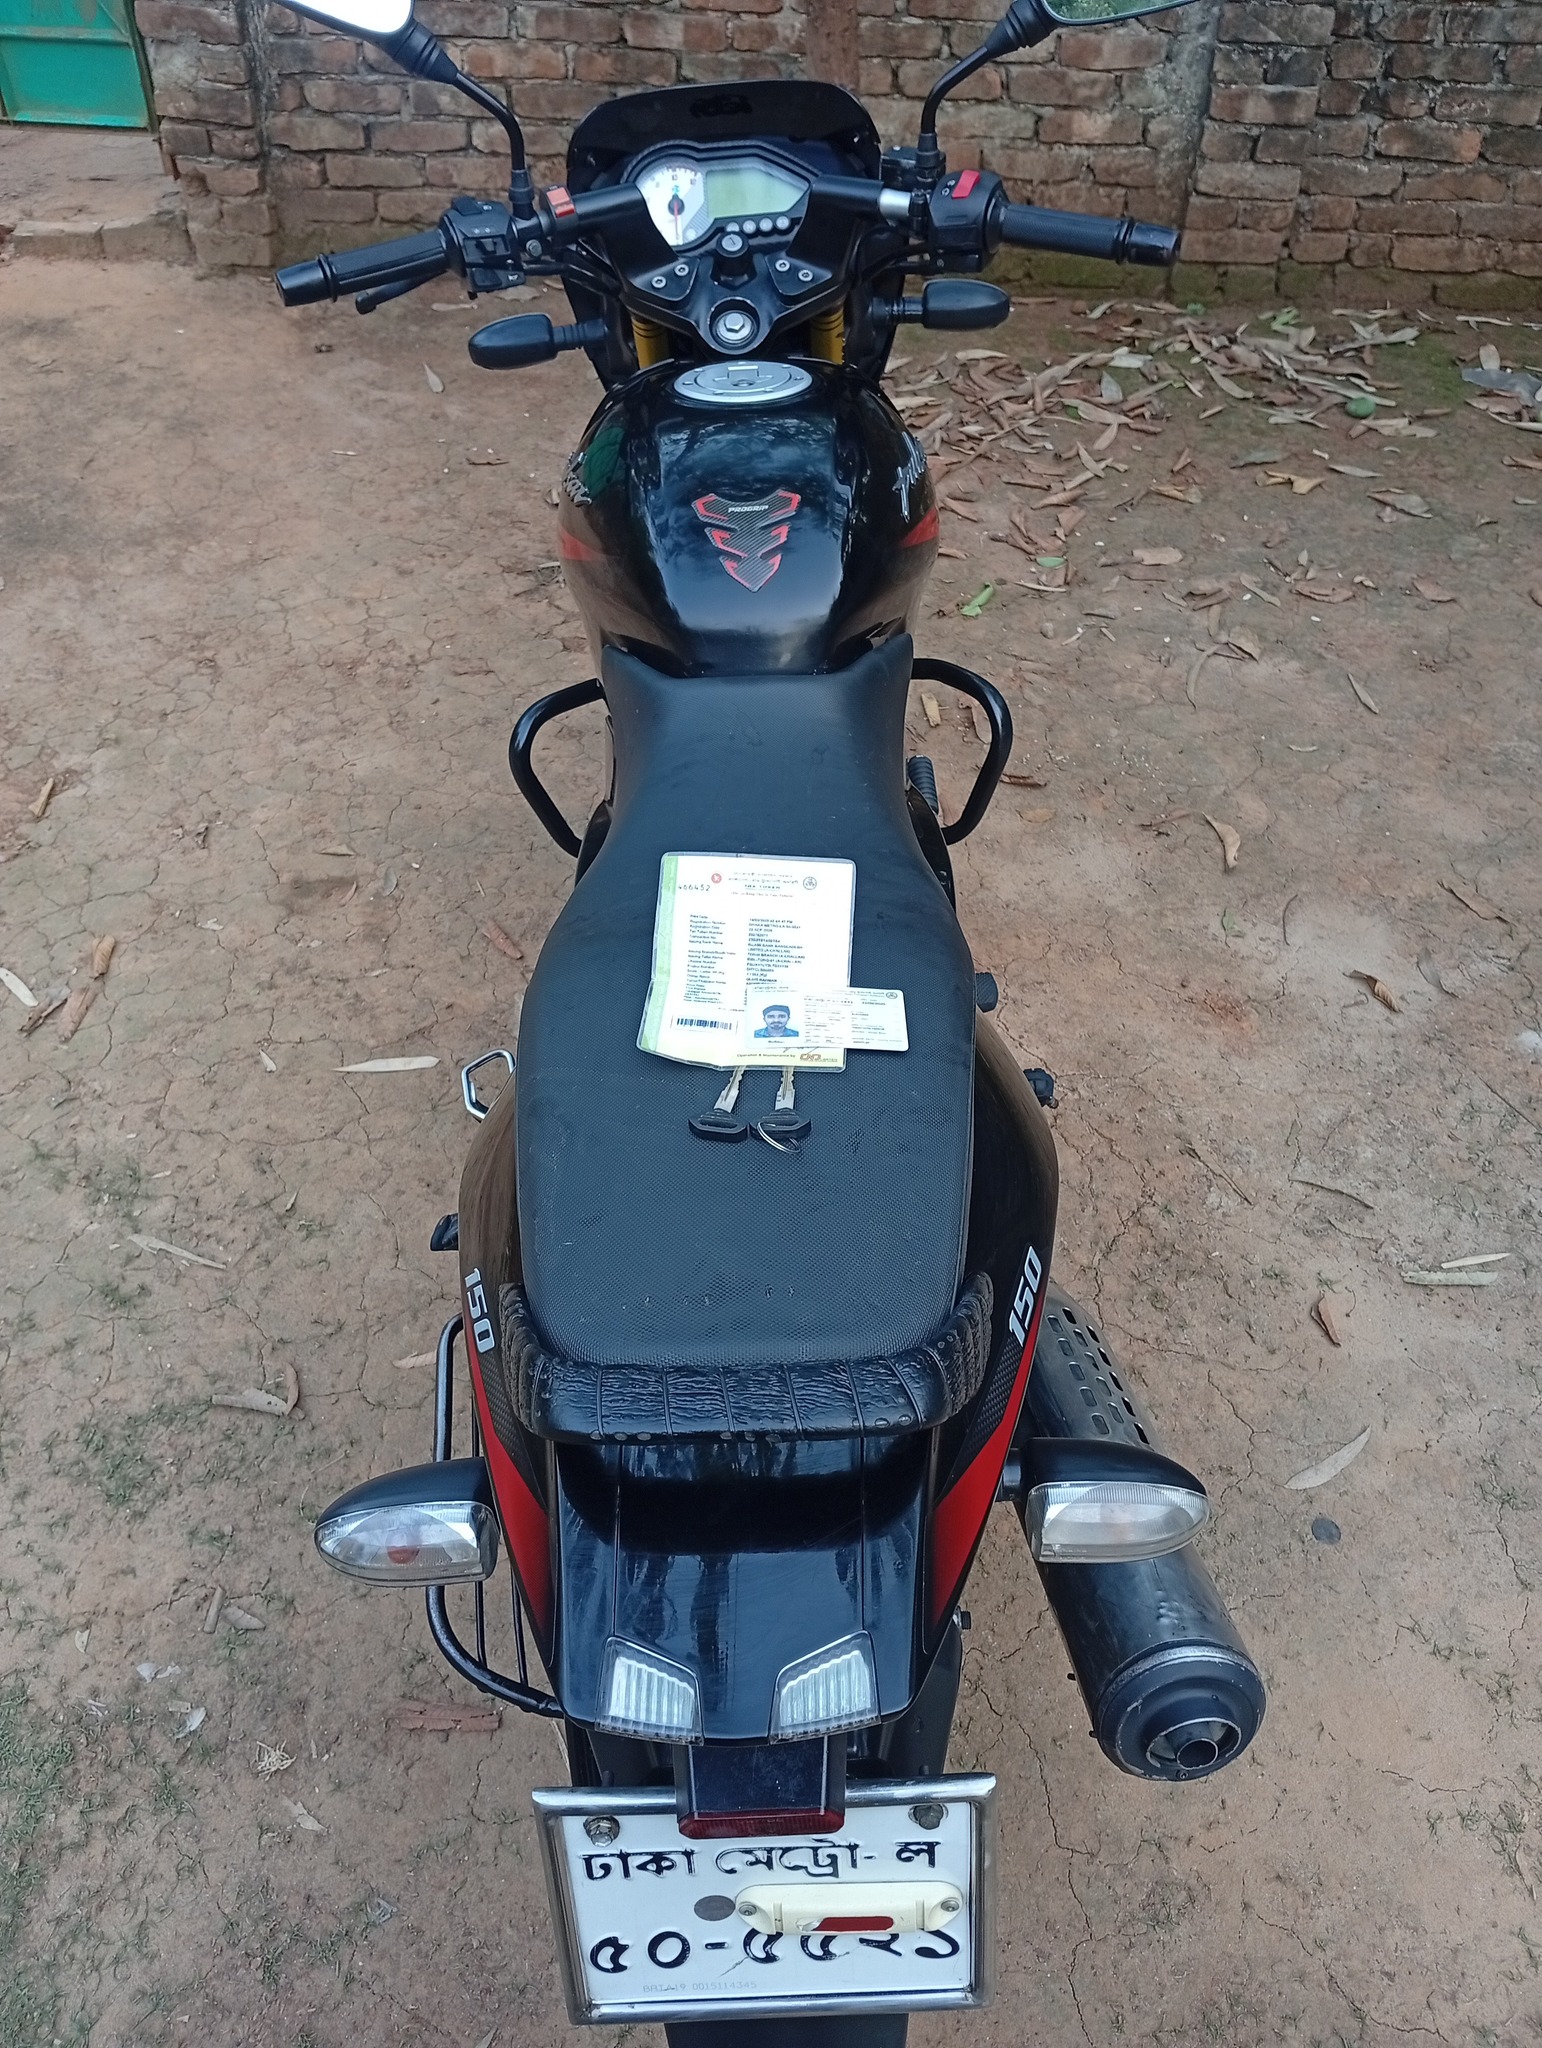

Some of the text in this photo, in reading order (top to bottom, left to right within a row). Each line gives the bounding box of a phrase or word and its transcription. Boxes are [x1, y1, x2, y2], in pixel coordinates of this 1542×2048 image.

[728, 505, 769, 513] PROGRIP
[464, 1267, 496, 1354] 150
[1009, 1245, 1042, 1348] 150
[582, 1848, 696, 1881] ঢাকা
[894, 1840, 942, 1869] ল
